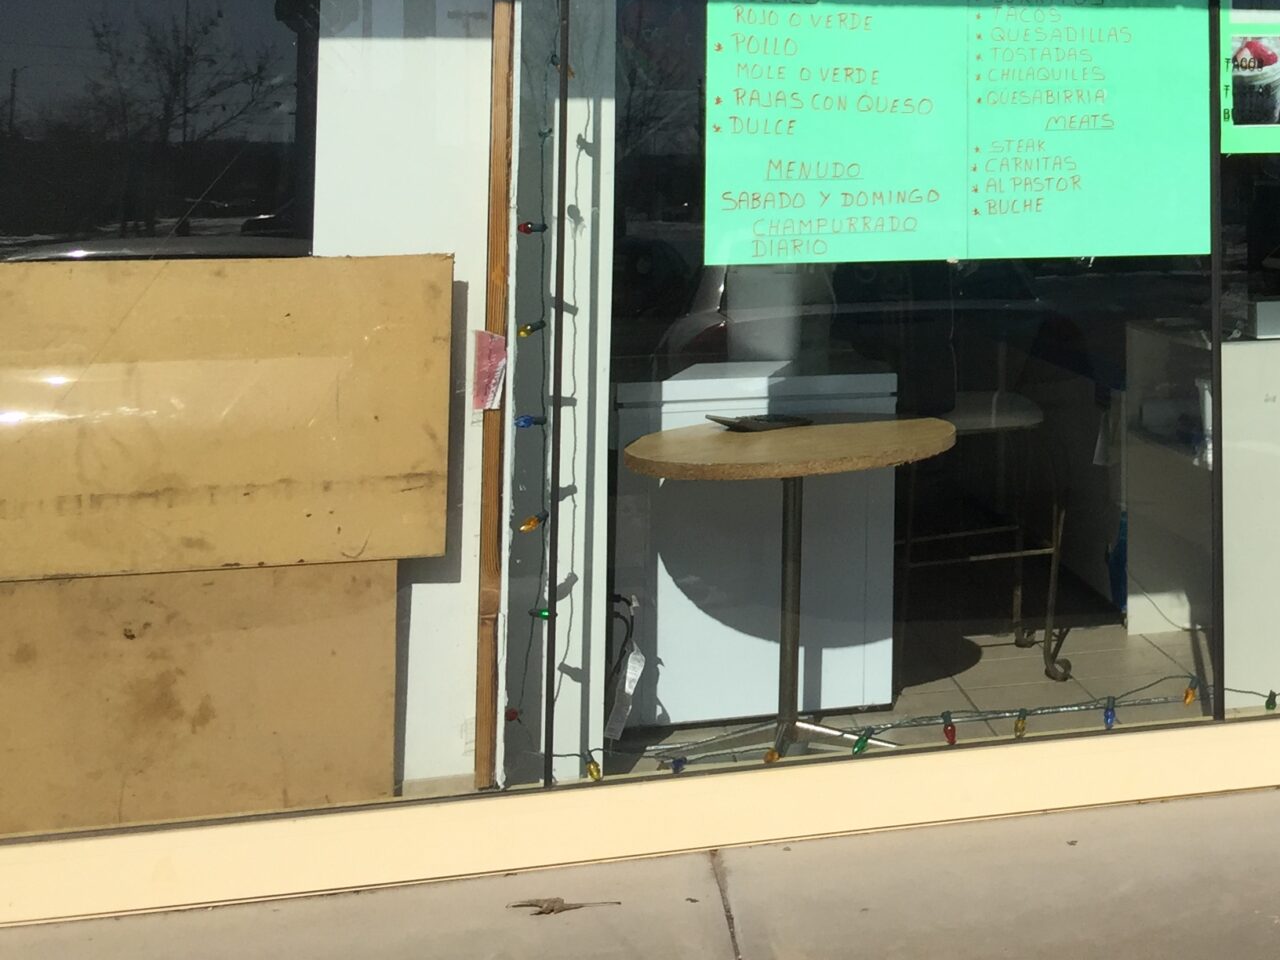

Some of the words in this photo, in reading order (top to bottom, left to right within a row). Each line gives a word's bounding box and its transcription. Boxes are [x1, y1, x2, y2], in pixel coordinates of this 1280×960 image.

[734, 5, 779, 27] ROJO
[788, 12, 802, 28] O
[809, 12, 874, 31] VERDE
[991, 6, 1063, 24] TACOS
[731, 32, 799, 56] POLLO
[989, 25, 1133, 45] QUESADILLAS
[989, 46, 1093, 63] TOSTADAS
[736, 63, 787, 81] MOLE
[799, 66, 812, 82] O
[820, 66, 880, 86] VERDE
[987, 65, 1106, 83] CHILAQUILES
[733, 88, 805, 111] RAJAS
[810, 93, 848, 112] CON
[856, 93, 934, 116] QUESO
[985, 88, 1108, 107] QUESABIRRIA
[728, 115, 797, 136] DULCE
[1045, 113, 1116, 131] MEATS
[989, 139, 1047, 154] STEAK
[765, 159, 863, 181] MENUDO
[984, 155, 1078, 173] CARNITAS
[985, 176, 1006, 193] AL
[1010, 174, 1083, 193] PASTOR
[720, 190, 806, 211] SABADO
[819, 190, 831, 208] Y
[840, 187, 941, 209] DOMINGO
[984, 197, 1045, 216] BUCHE
[751, 216, 919, 237] CHAMPURRADO
[751, 238, 829, 259] DIARIO
